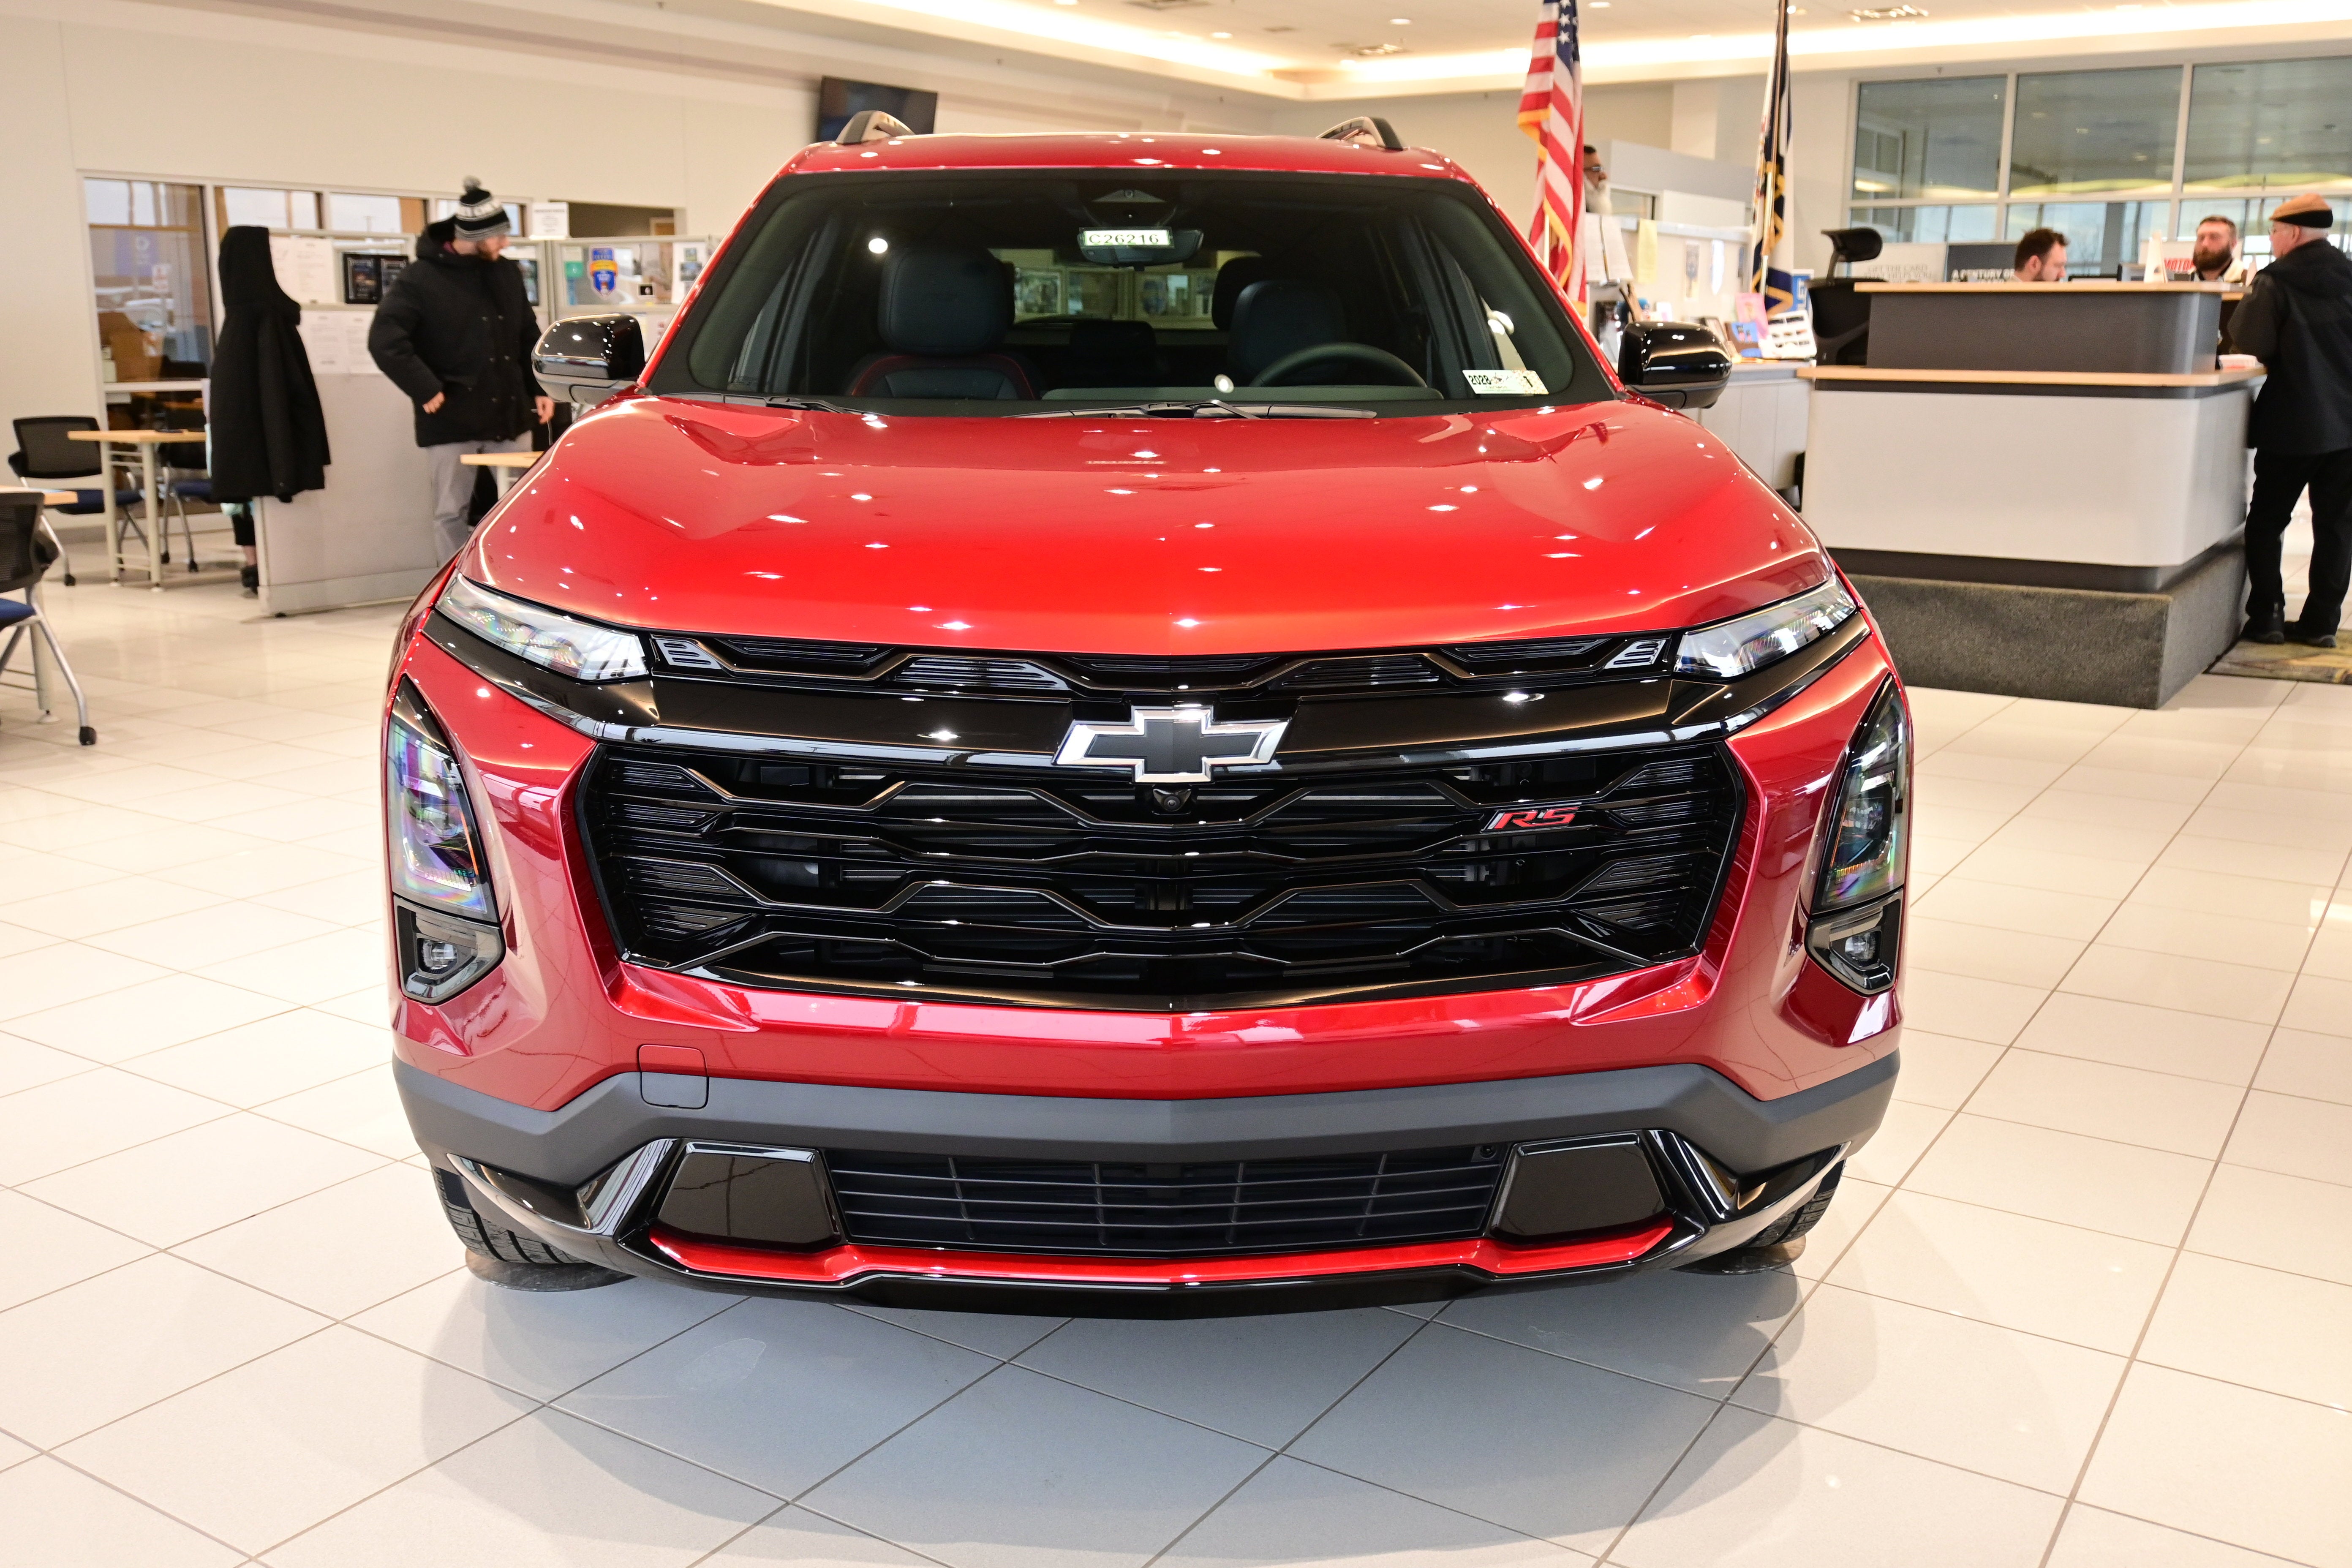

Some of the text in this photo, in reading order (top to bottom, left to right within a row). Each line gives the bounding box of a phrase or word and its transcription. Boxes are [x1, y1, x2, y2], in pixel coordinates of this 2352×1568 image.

[1089, 234, 1159, 245] C26216
[1468, 374, 1492, 385] 2028
[1523, 376, 1534, 388] 1
[1493, 806, 1580, 830] RS
